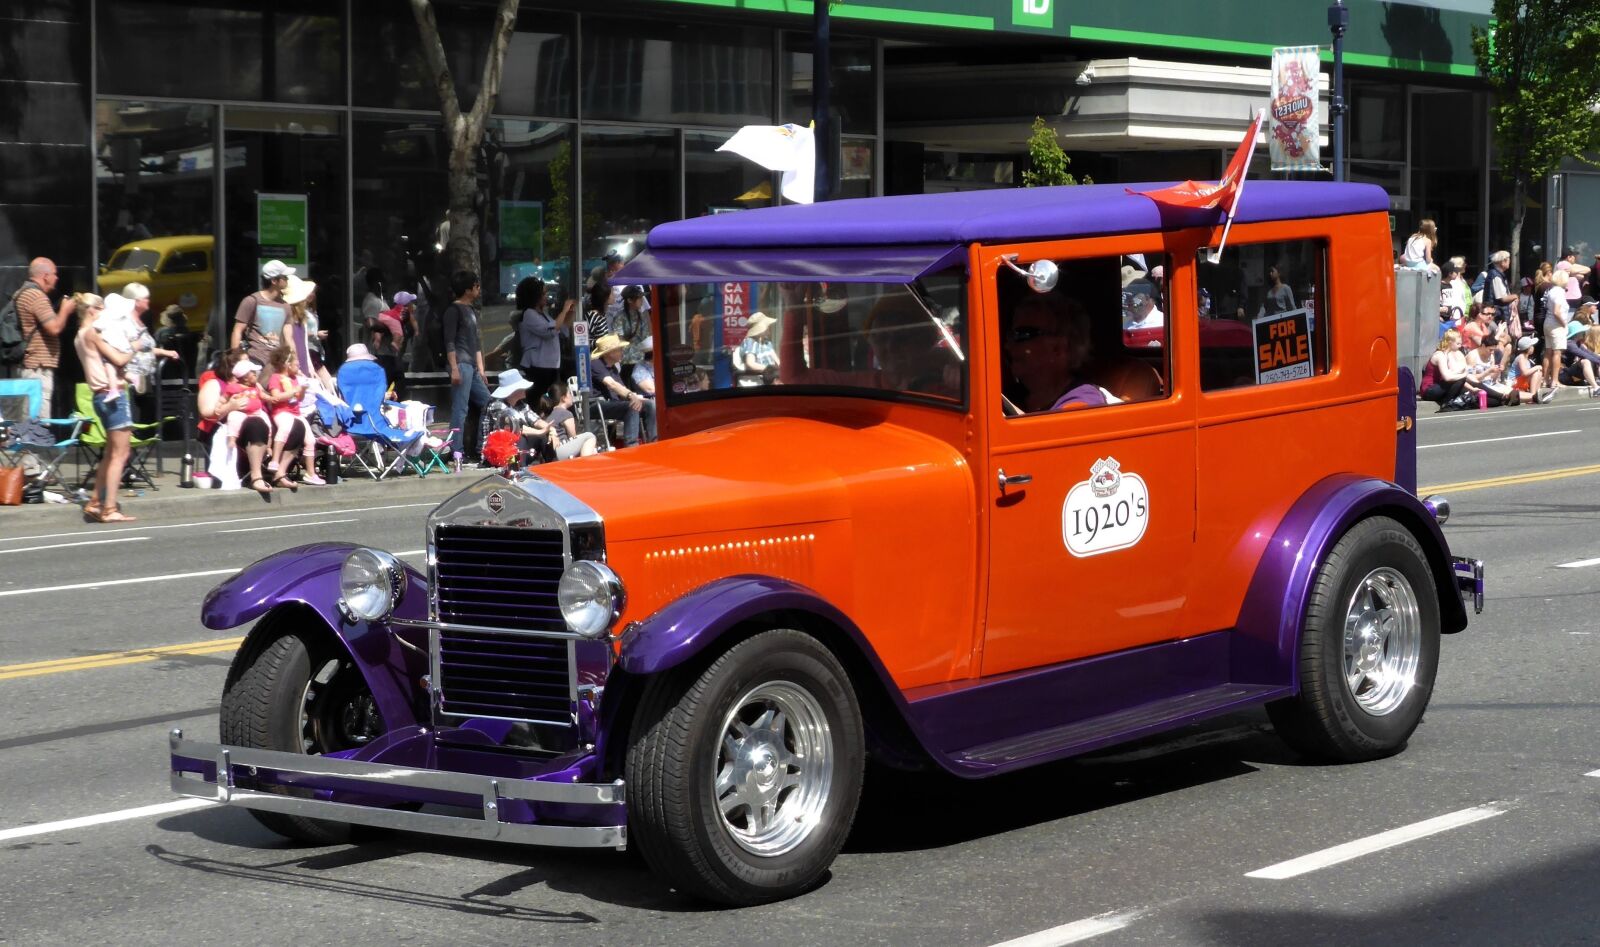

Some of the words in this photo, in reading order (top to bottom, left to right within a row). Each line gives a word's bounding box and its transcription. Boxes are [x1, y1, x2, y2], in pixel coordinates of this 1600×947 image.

[724, 282, 743, 293] CA
[724, 294, 743, 305] NA
[724, 305, 743, 316] DA
[1269, 319, 1297, 340] FOR
[1259, 334, 1309, 370] SALE
[1072, 491, 1146, 545] 1920's
